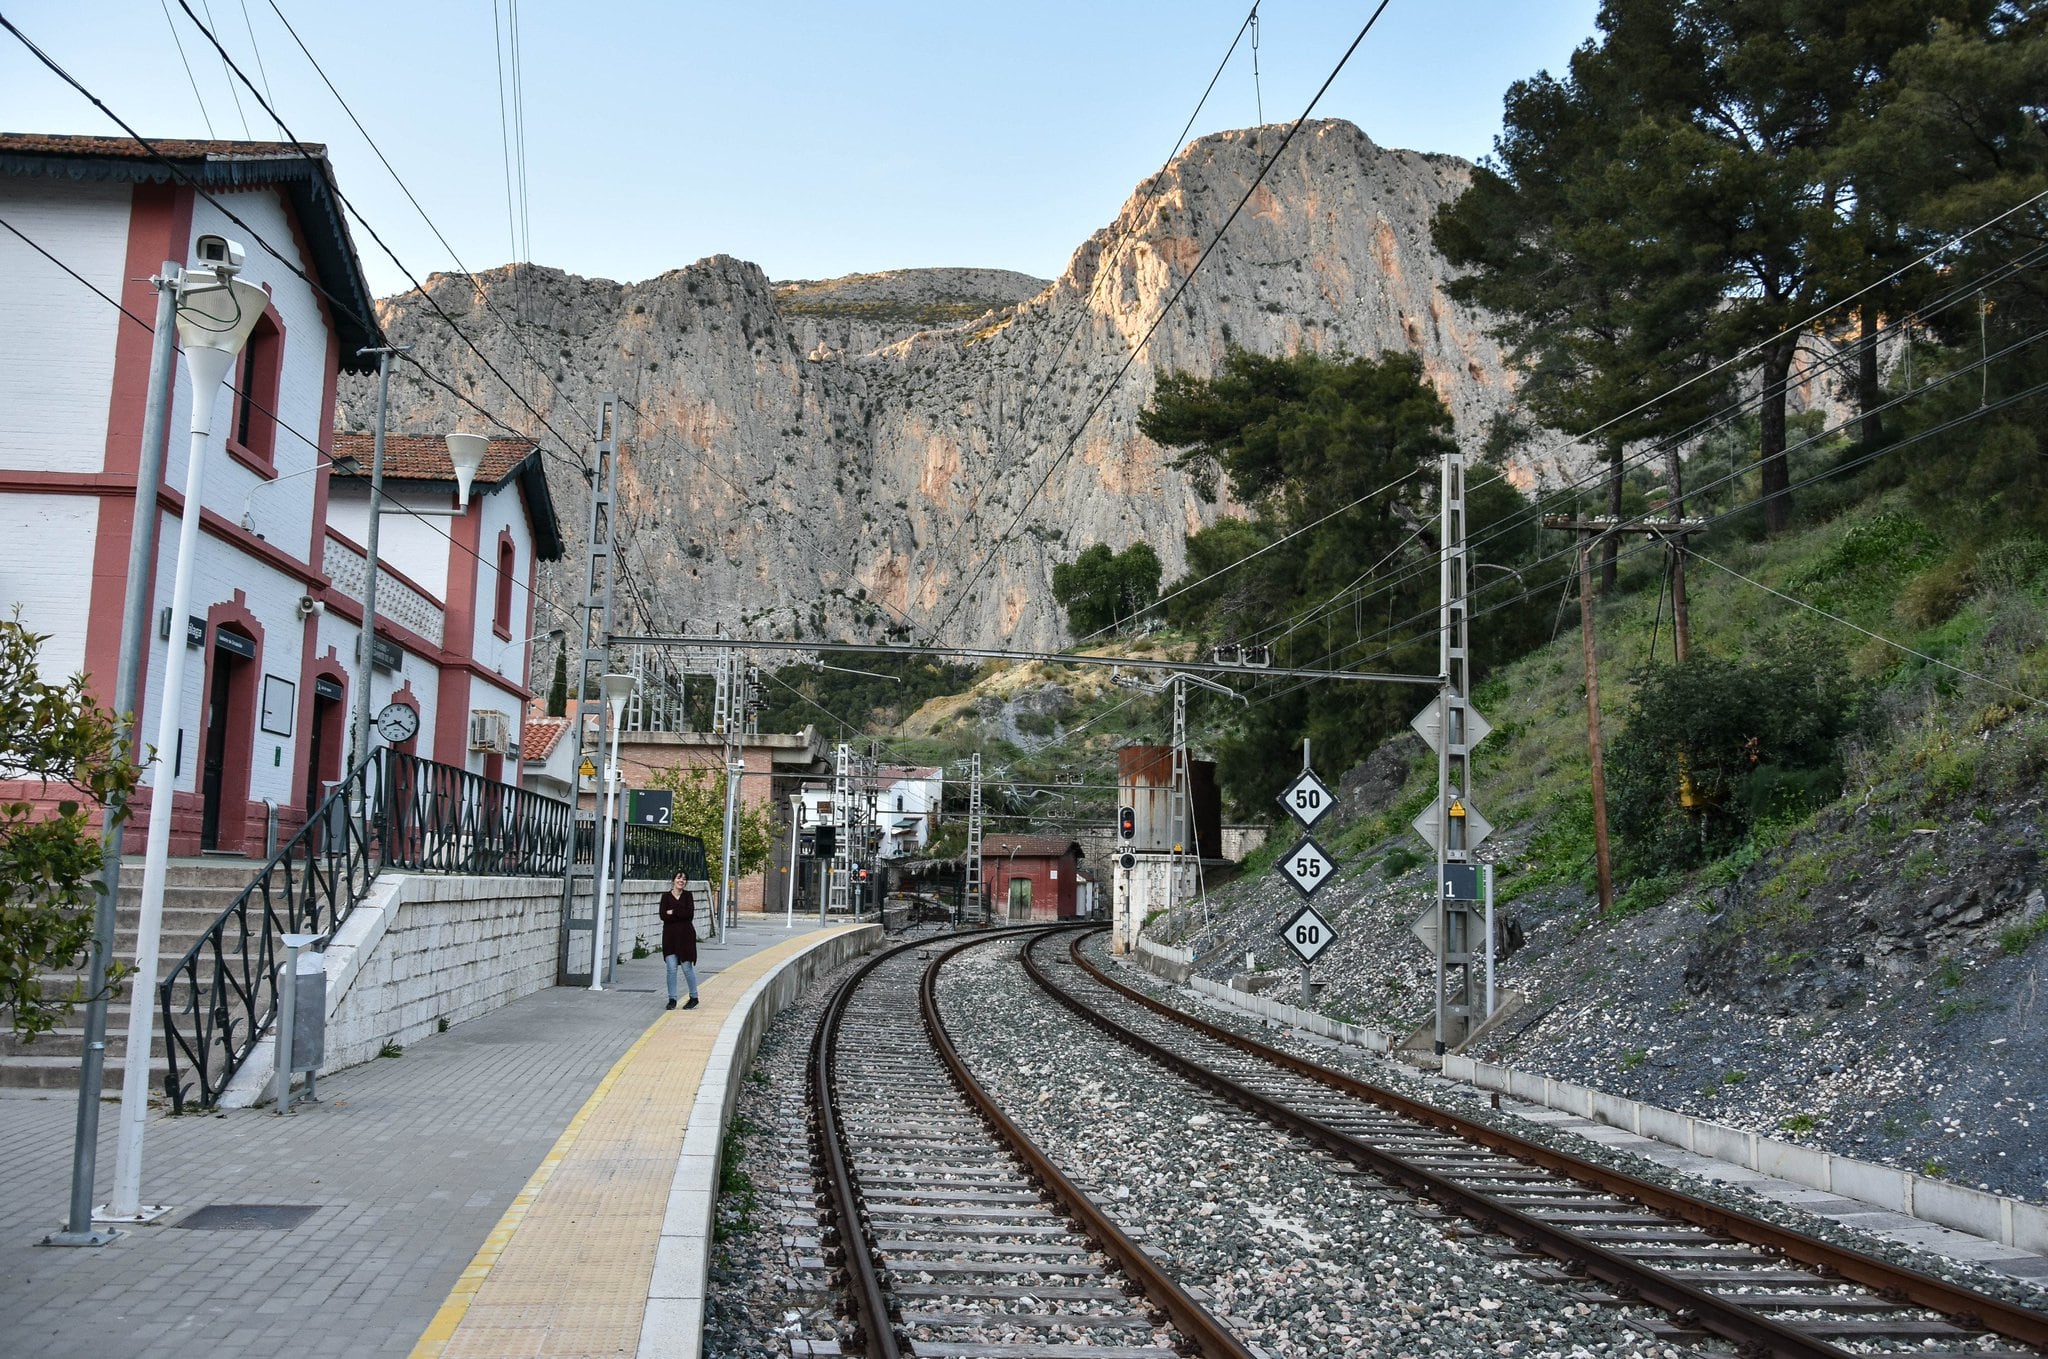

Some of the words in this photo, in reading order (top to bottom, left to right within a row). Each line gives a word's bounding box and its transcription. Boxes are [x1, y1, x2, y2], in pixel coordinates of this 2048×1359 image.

[1296, 789, 1320, 809] 50
[659, 807, 669, 824] 2
[1296, 858, 1320, 878] 55
[1445, 881, 1456, 898] 1
[1296, 925, 1319, 945] 60
